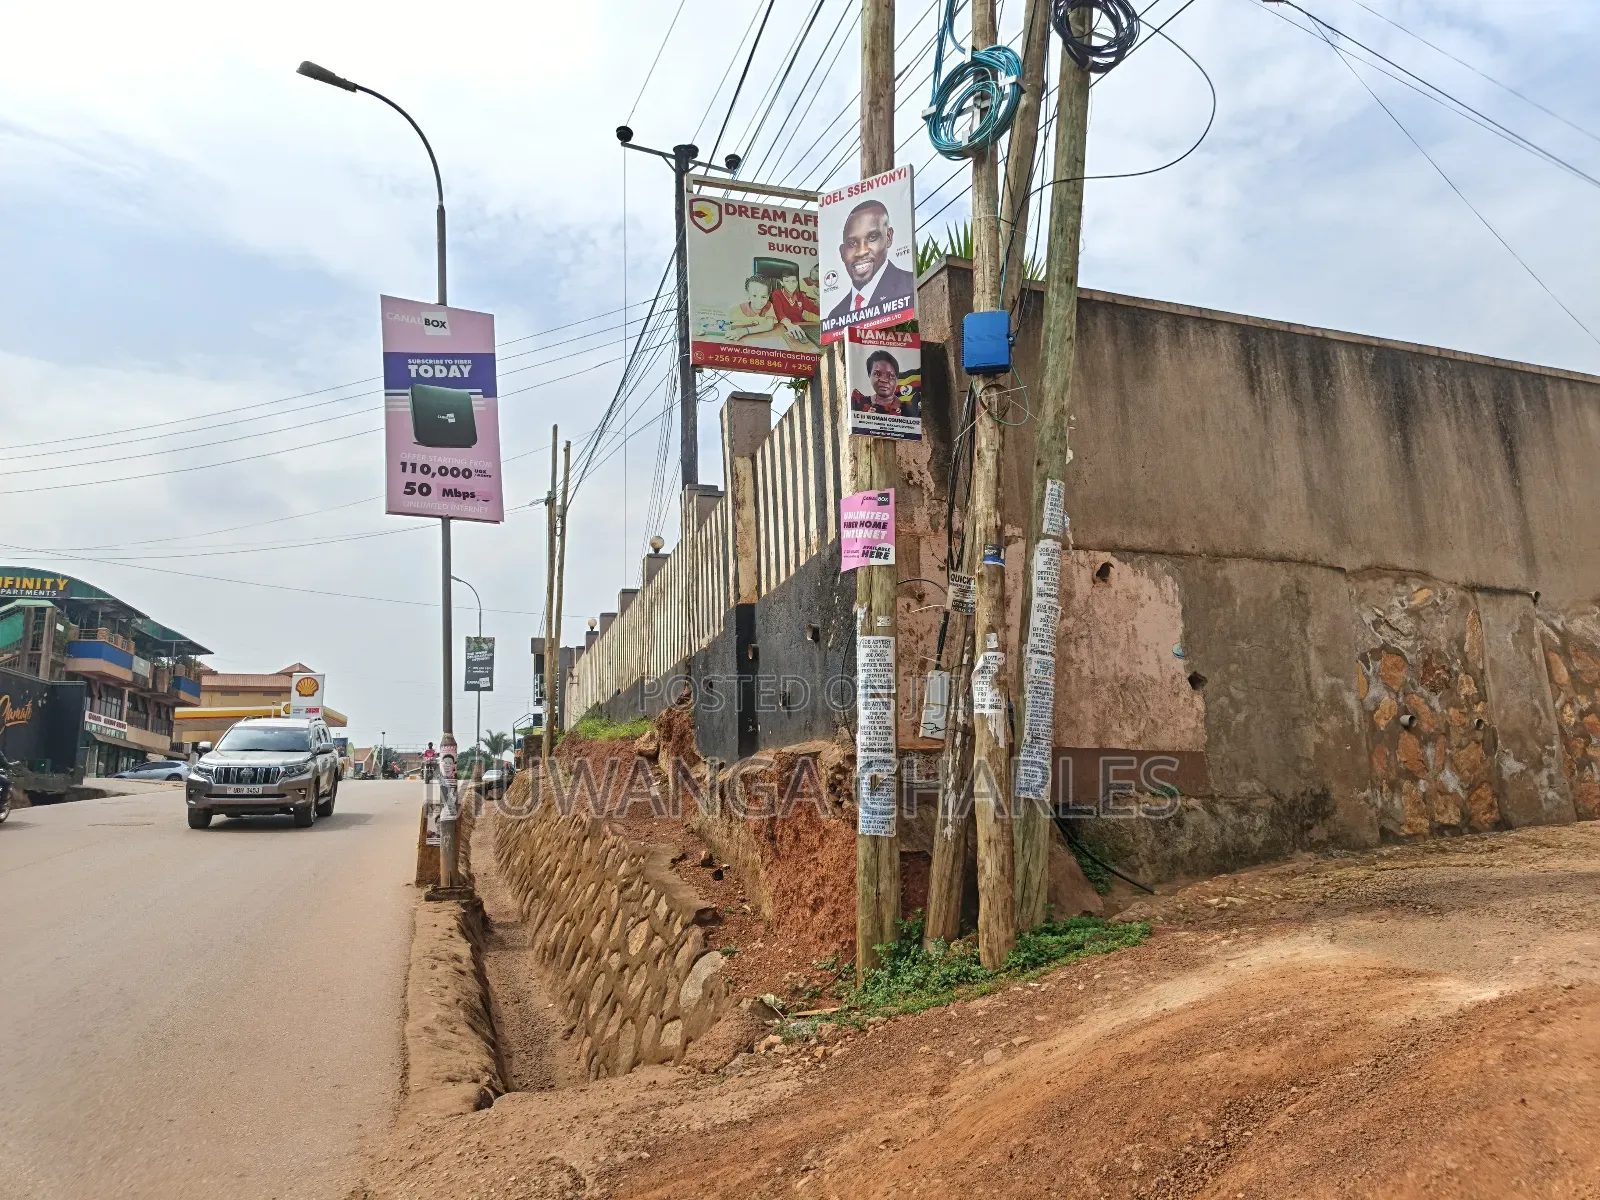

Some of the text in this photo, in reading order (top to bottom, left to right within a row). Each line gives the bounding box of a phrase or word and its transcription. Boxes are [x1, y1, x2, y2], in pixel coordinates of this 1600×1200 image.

[820, 168, 907, 207] JOEL SSENYONYI
[724, 202, 787, 224] DREAM
[768, 242, 818, 256] BUKOTO
[386, 312, 448, 329] CANAL BOX
[822, 306, 880, 332] MP-NAKAWA
[882, 296, 911, 314] WEST
[856, 328, 913, 342] NAMATA
[708, 354, 730, 362] +256
[732, 356, 748, 364] 776
[766, 360, 782, 368] 846
[792, 364, 812, 372] +256
[408, 364, 472, 378] TODAY
[428, 455, 467, 465] STARTING
[400, 462, 472, 480] 110,000
[403, 482, 476, 500] 50 Mbps
[404, 501, 448, 510] UNLIMITED
[844, 510, 890, 520] UNLIMITED
[859, 520, 888, 530] HOME
[844, 529, 888, 540] INTERNET
[861, 550, 890, 560] HERE
